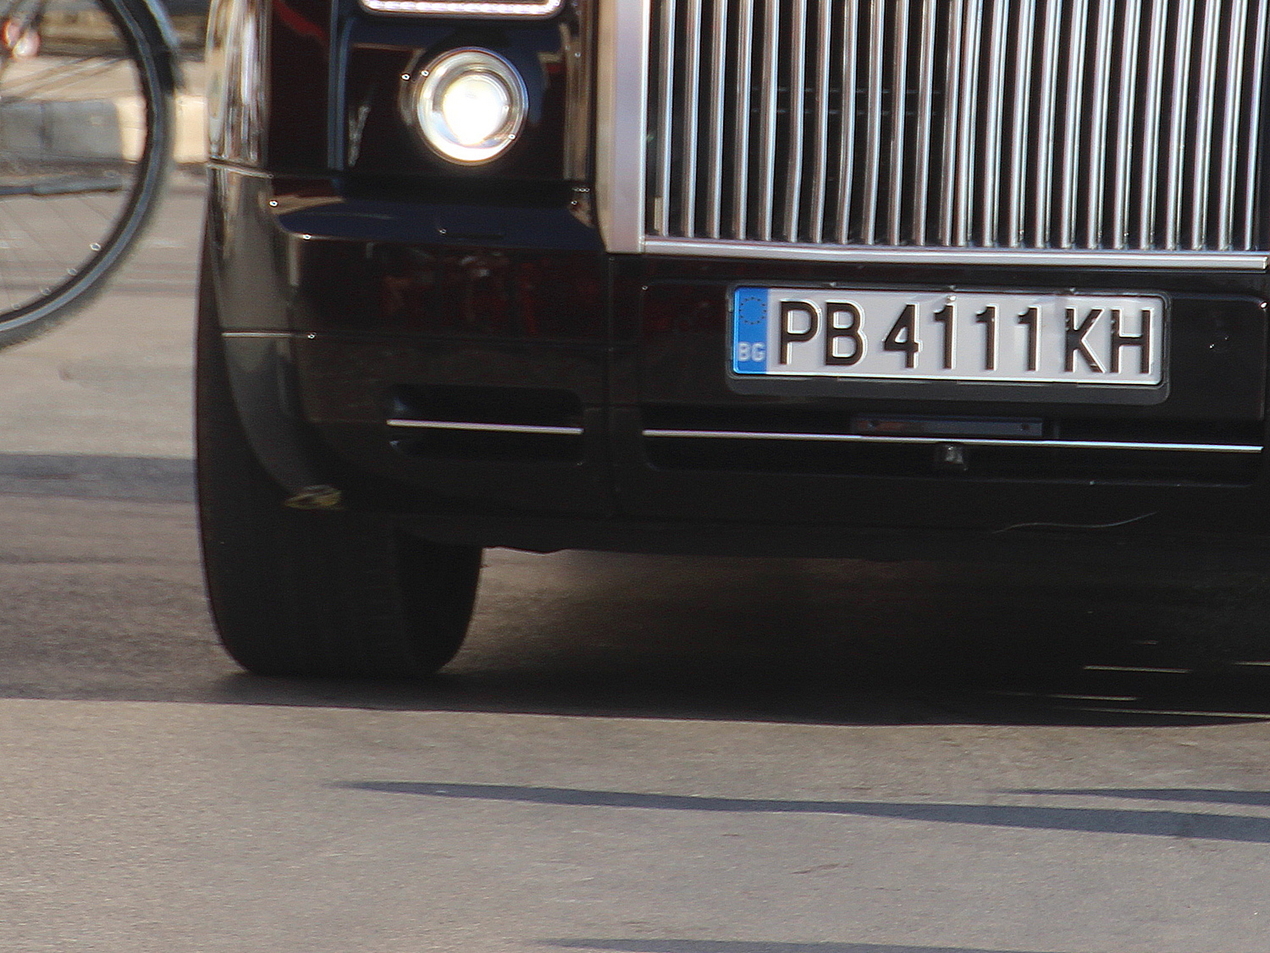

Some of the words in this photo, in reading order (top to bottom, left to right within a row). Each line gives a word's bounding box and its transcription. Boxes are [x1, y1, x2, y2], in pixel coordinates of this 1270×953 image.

[737, 342, 766, 363] BG
[778, 299, 867, 367] PB
[883, 302, 1042, 372] 4111
[1062, 306, 1155, 375] KH
